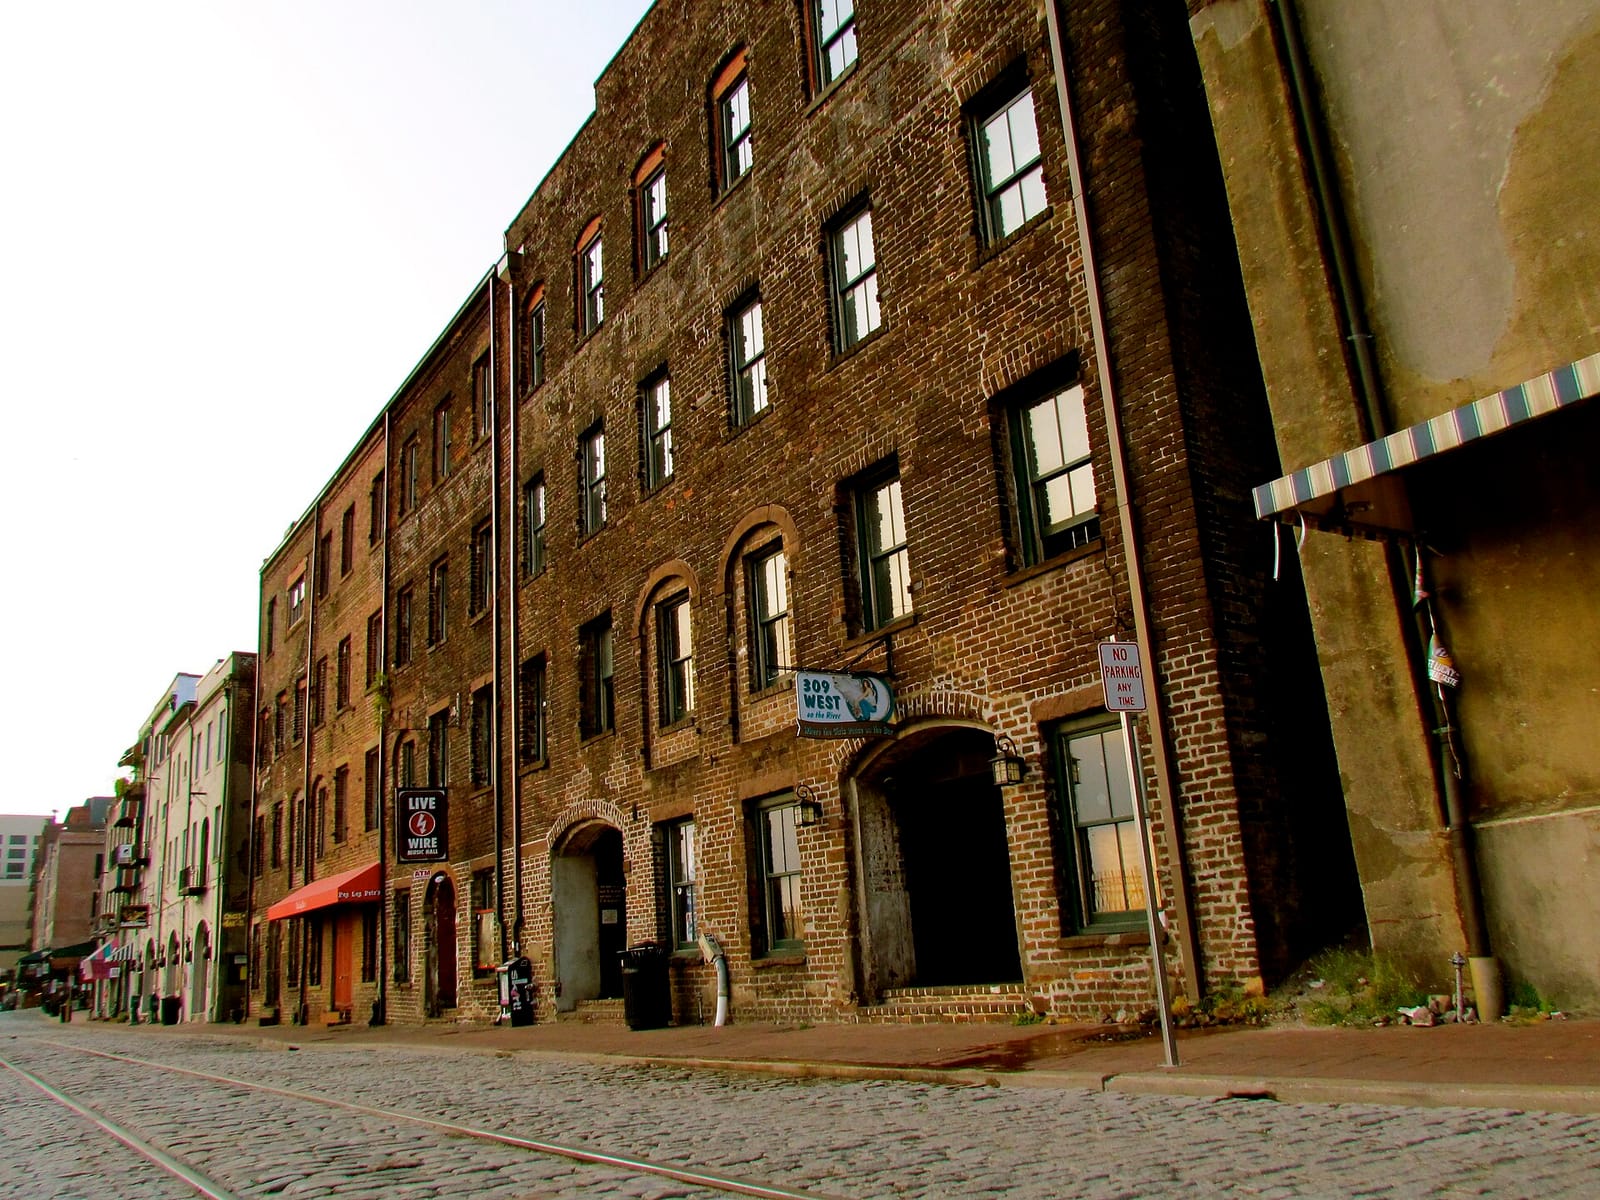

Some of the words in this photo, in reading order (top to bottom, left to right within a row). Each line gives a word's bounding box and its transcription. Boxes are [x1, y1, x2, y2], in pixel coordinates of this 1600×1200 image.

[1112, 648, 1127, 661] NO
[1104, 665, 1140, 679] PARKING
[803, 678, 830, 694] 309
[1117, 682, 1132, 692] ANY
[803, 694, 841, 710] WEST
[1117, 696, 1135, 706] TIME
[815, 711, 824, 719] the
[826, 711, 841, 719] River
[408, 796, 436, 810] LIVE
[407, 837, 438, 849] WIRE
